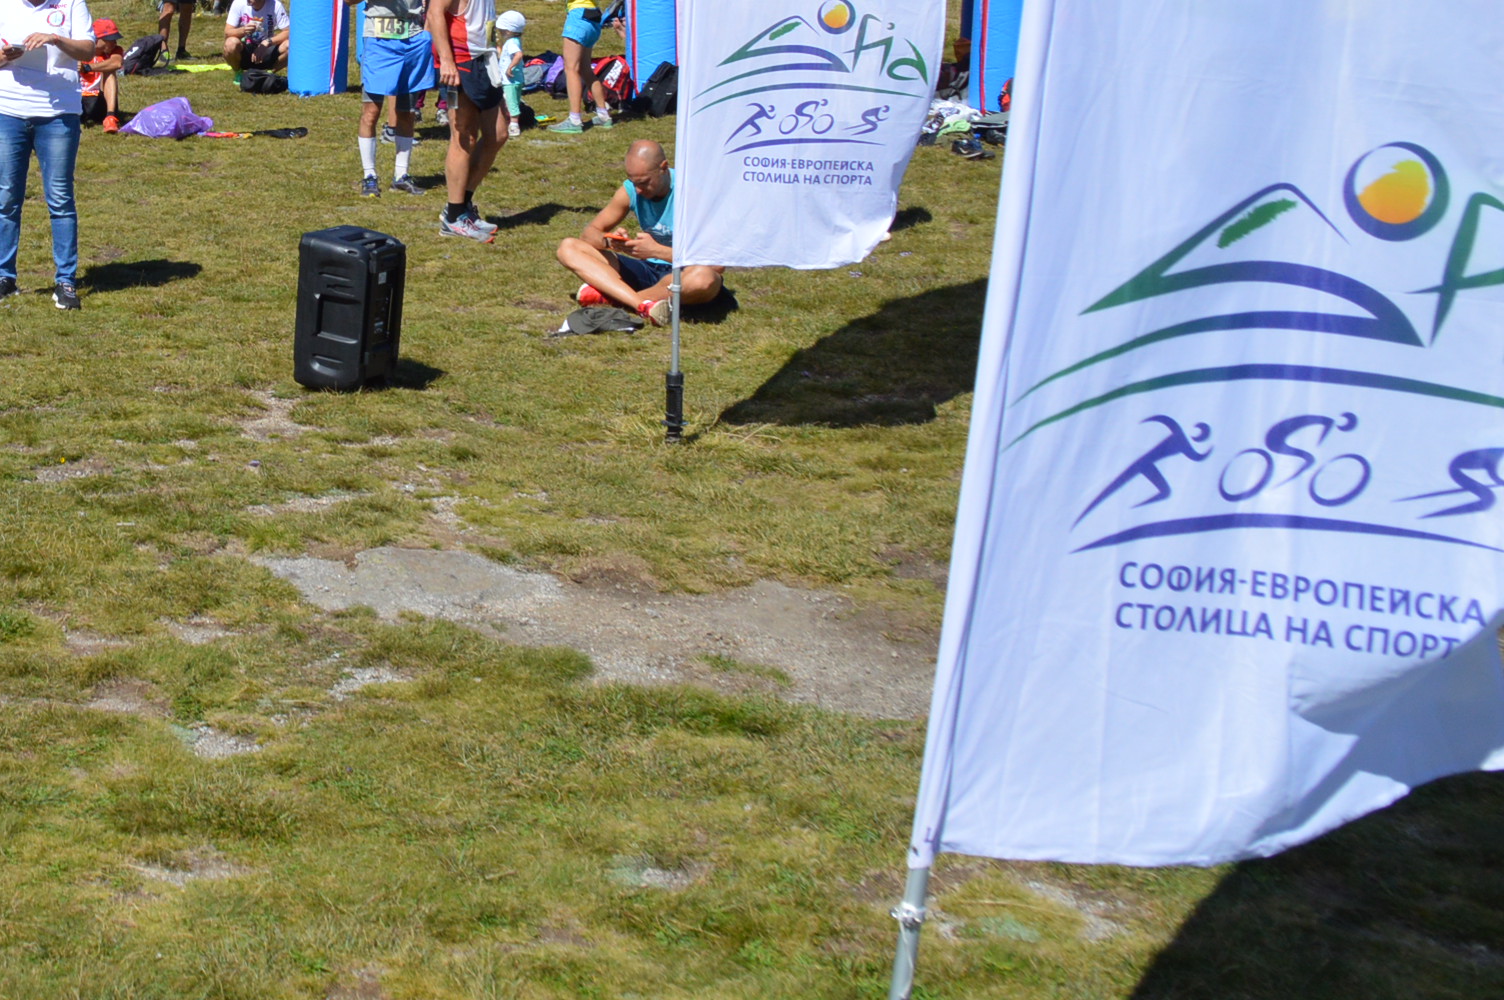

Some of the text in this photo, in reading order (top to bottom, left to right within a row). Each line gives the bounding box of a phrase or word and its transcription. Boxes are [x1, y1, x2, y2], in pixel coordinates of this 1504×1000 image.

[378, 17, 405, 35] 143
[743, 171, 873, 186] СТОЛИЦА НА СПОРТА
[1115, 602, 1461, 659] СТОЛИЦА НА СПОРТ
